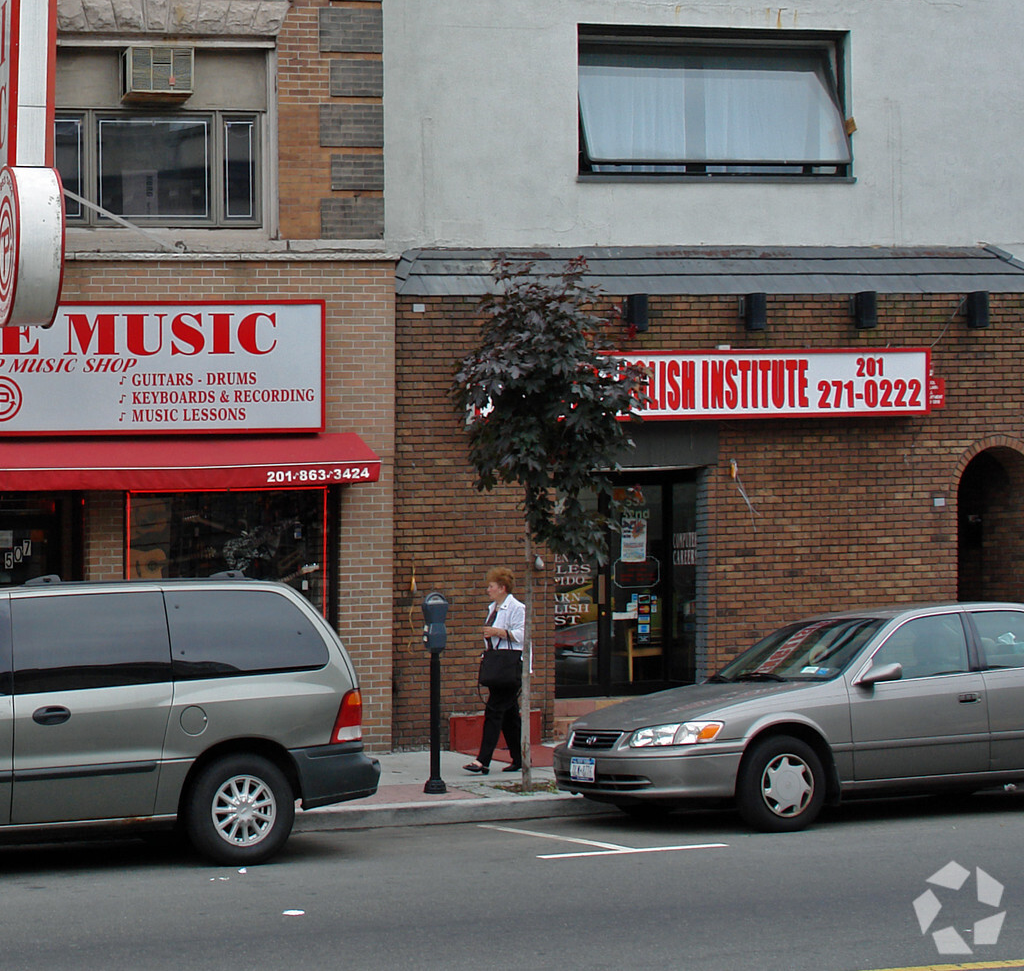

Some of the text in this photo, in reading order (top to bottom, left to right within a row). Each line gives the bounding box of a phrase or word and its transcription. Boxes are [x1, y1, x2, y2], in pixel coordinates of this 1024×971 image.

[63, 312, 278, 357] MUSIC
[8, 358, 76, 374] MUSIC
[82, 357, 138, 373] SHOP
[856, 357, 884, 377] 201
[131, 372, 194, 387] GUITARS
[207, 372, 257, 386] DRUMS
[702, 358, 809, 410] INSTITUTE
[131, 388, 315, 405] KEYBOARDS & RECORDING
[817, 379, 922, 409] 271-0222
[131, 407, 247, 423] MUSIC LESSONS
[5, 541, 30, 568] 507
[555, 603, 590, 614] LISH
[555, 615, 581, 626] ST
